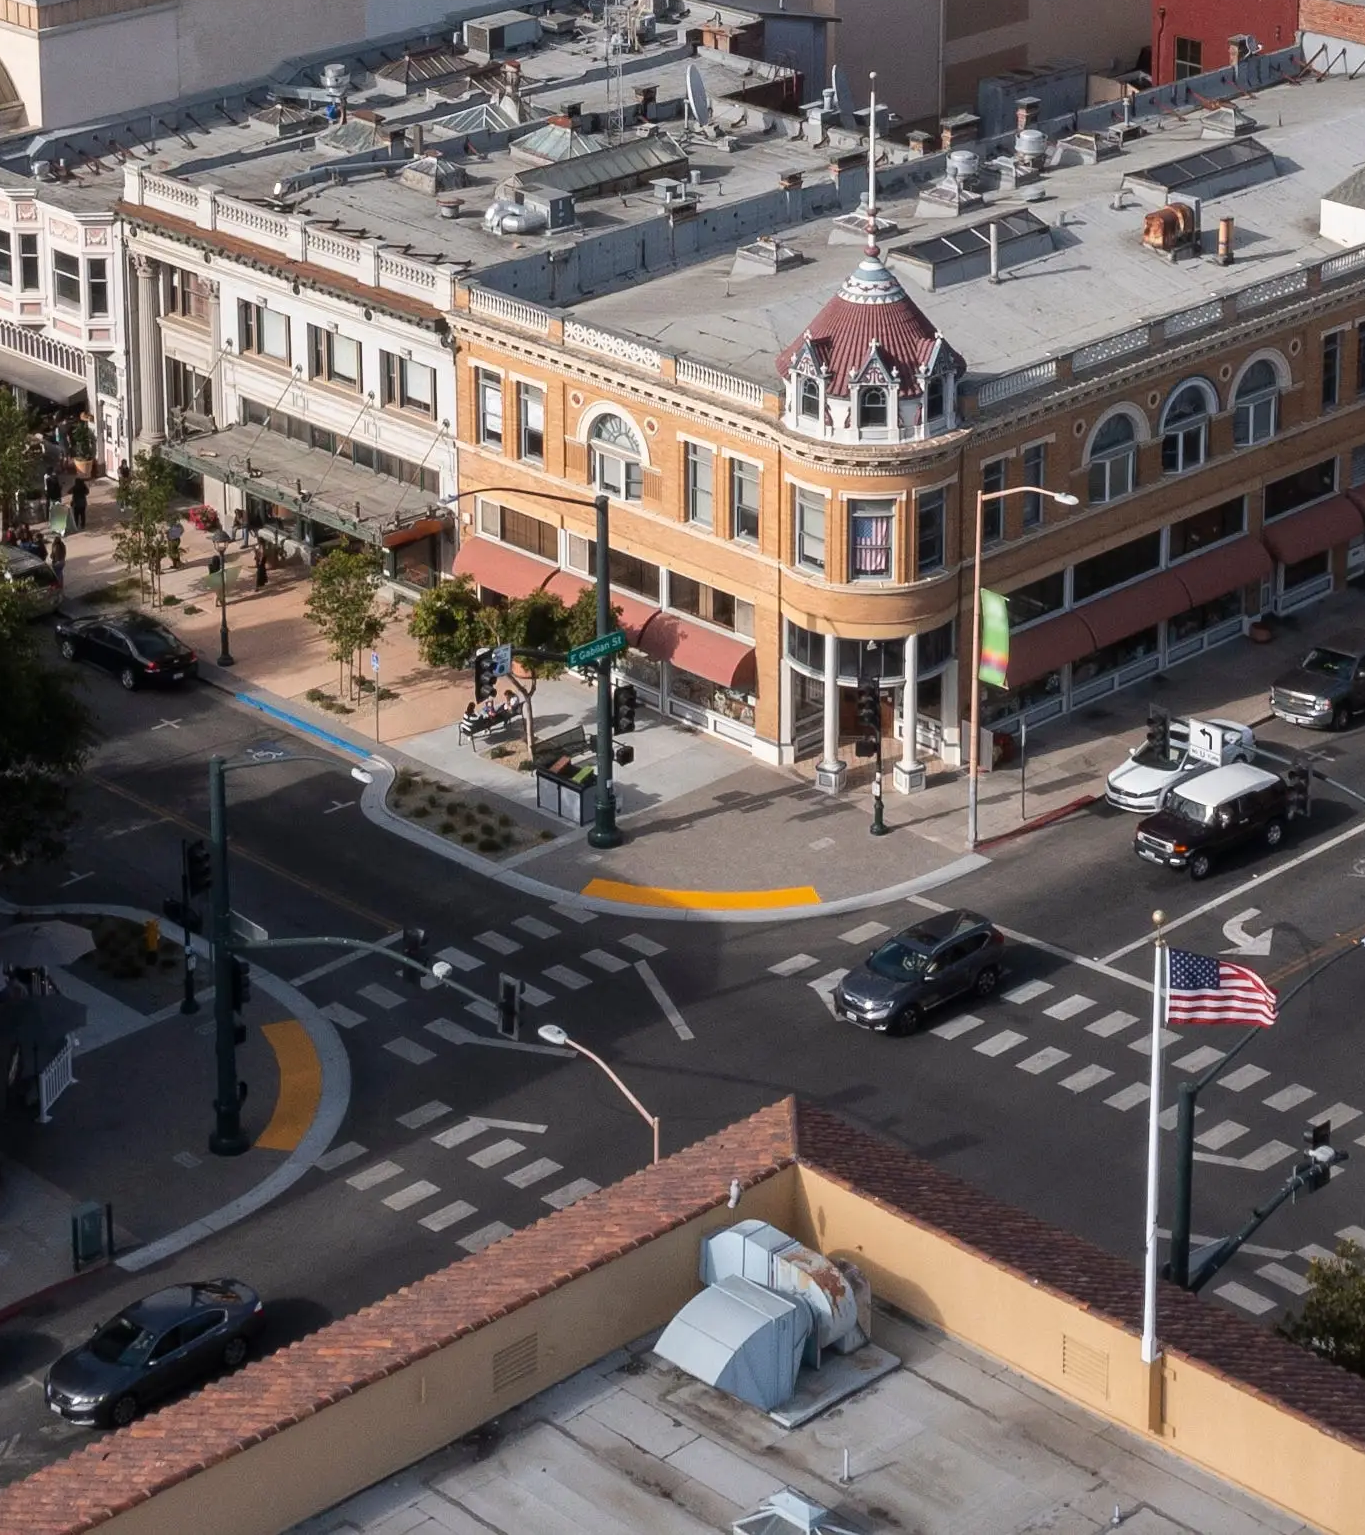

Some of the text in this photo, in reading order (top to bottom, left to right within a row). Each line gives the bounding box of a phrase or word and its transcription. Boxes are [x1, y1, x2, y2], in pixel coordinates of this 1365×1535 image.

[570, 636, 622, 664] E Gabilan St
